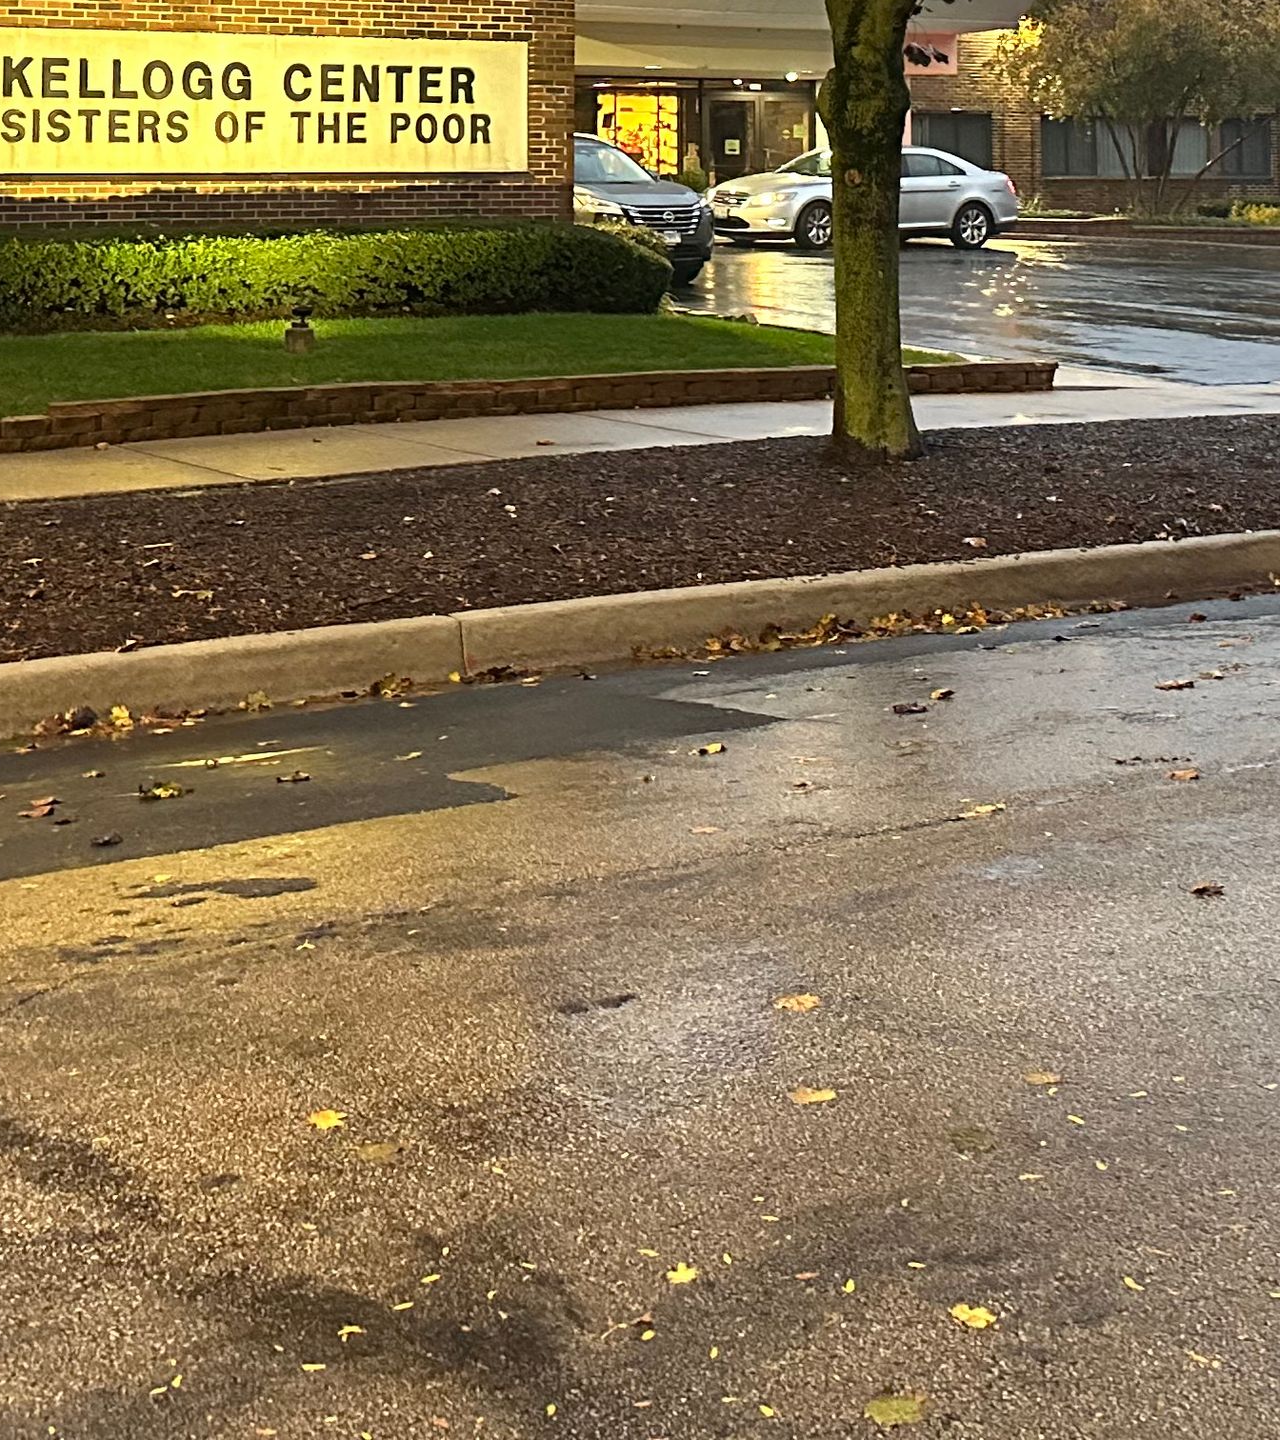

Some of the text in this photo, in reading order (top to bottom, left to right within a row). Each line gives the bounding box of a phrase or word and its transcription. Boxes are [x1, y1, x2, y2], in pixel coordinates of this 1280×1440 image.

[3, 56, 252, 100] KELLOGG
[284, 62, 476, 104] CENTER
[0, 109, 189, 143] SISTERS
[215, 111, 266, 144] OF
[290, 111, 368, 144] THE
[390, 112, 492, 144] POOR
